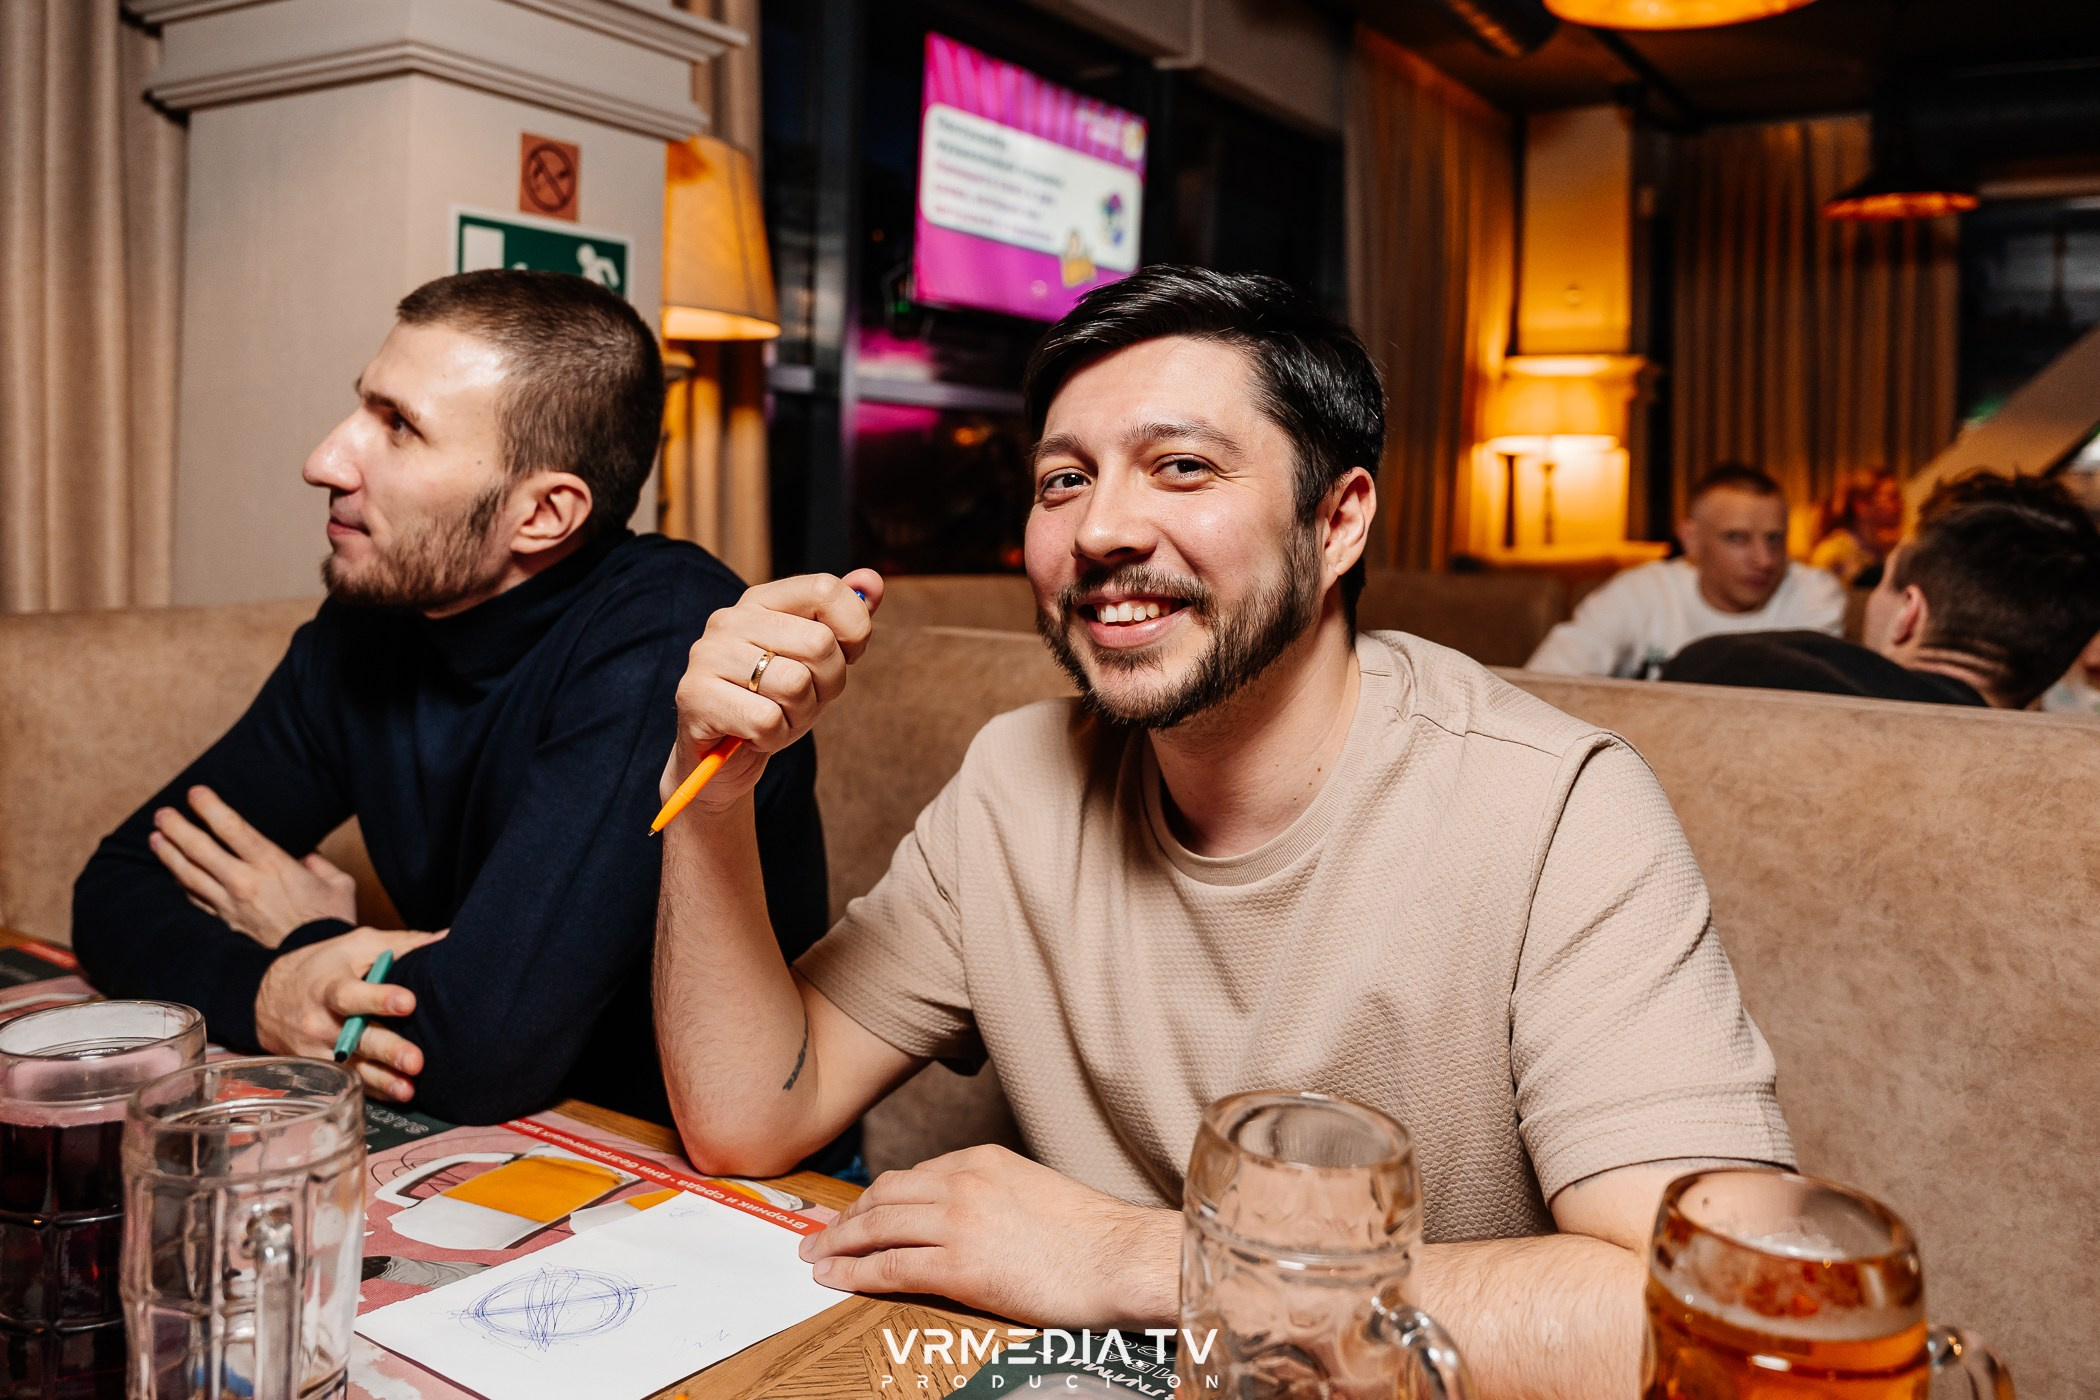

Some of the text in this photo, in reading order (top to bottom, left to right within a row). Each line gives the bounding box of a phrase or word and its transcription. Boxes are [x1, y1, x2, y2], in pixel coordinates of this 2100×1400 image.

[541, 1131, 639, 1169] безграничных
[638, 1165, 672, 1181] дни
[677, 1179, 726, 1201] среда
[725, 1196, 738, 1205] и
[736, 1200, 809, 1230] Вторник
